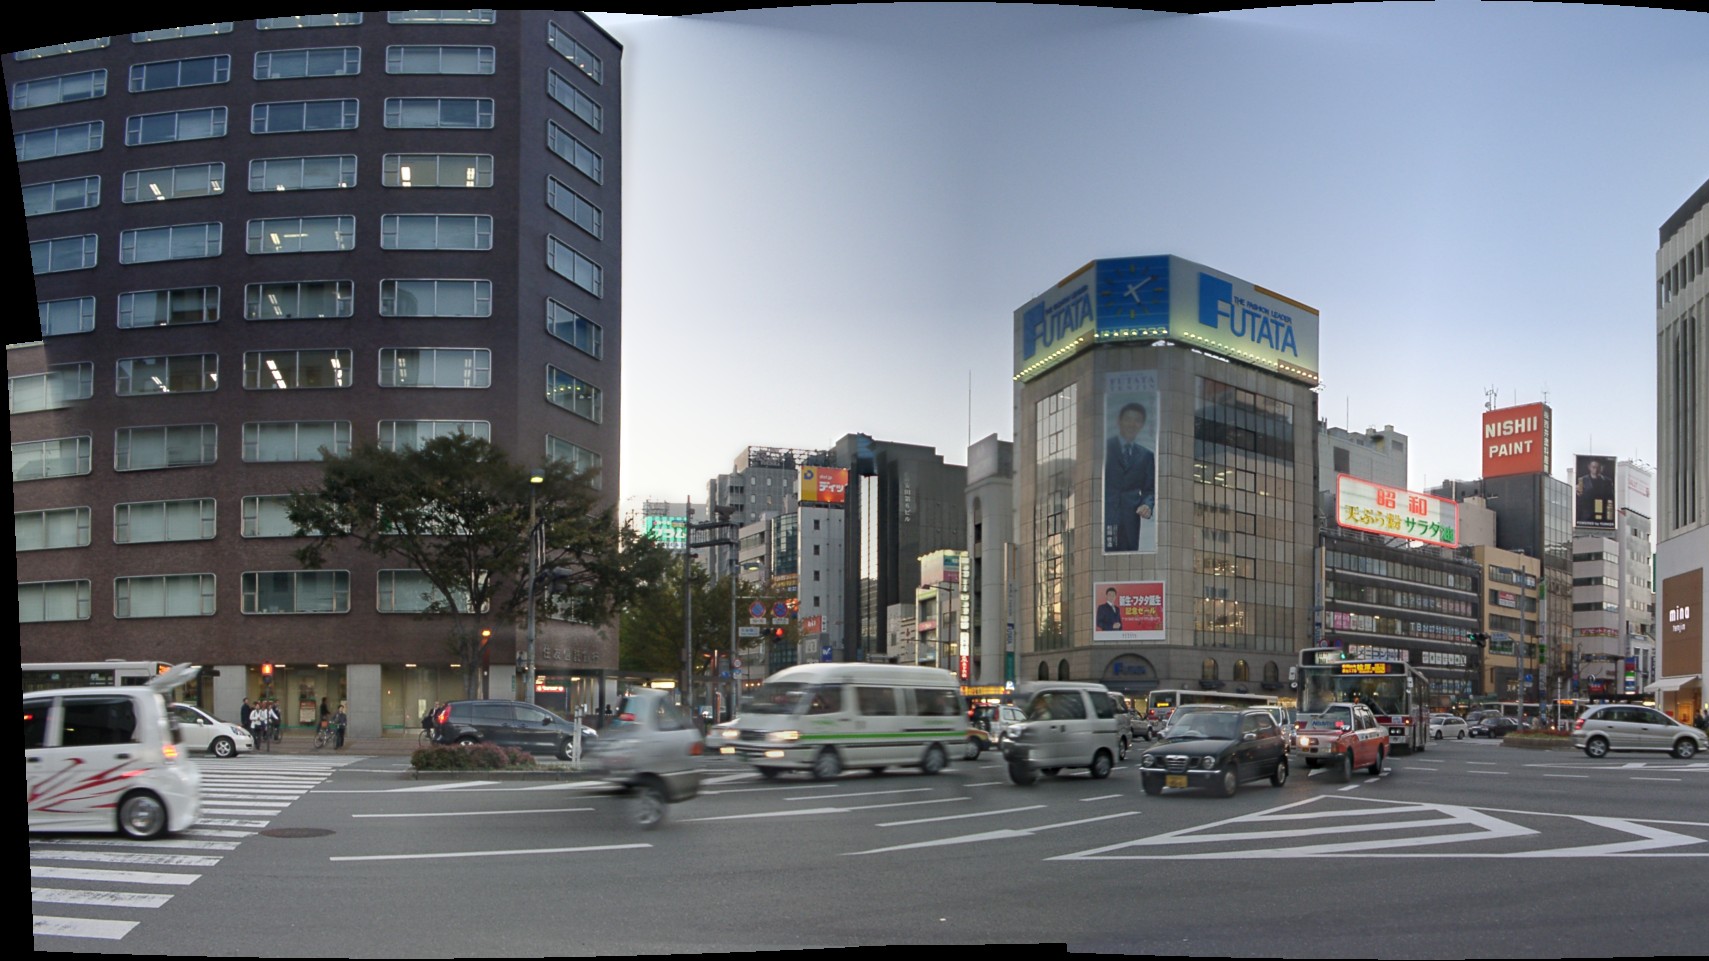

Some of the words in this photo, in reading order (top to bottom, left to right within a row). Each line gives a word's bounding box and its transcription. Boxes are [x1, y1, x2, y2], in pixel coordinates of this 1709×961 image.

[1023, 292, 1094, 360] FUTATA
[1199, 272, 1297, 357] FUTATA
[1485, 416, 1537, 438] NISHII
[1489, 440, 1532, 458] PAINT
[1376, 489, 1428, 516] 昭和
[1404, 516, 1454, 543] サラダ油
[1669, 605, 1690, 622] mina
